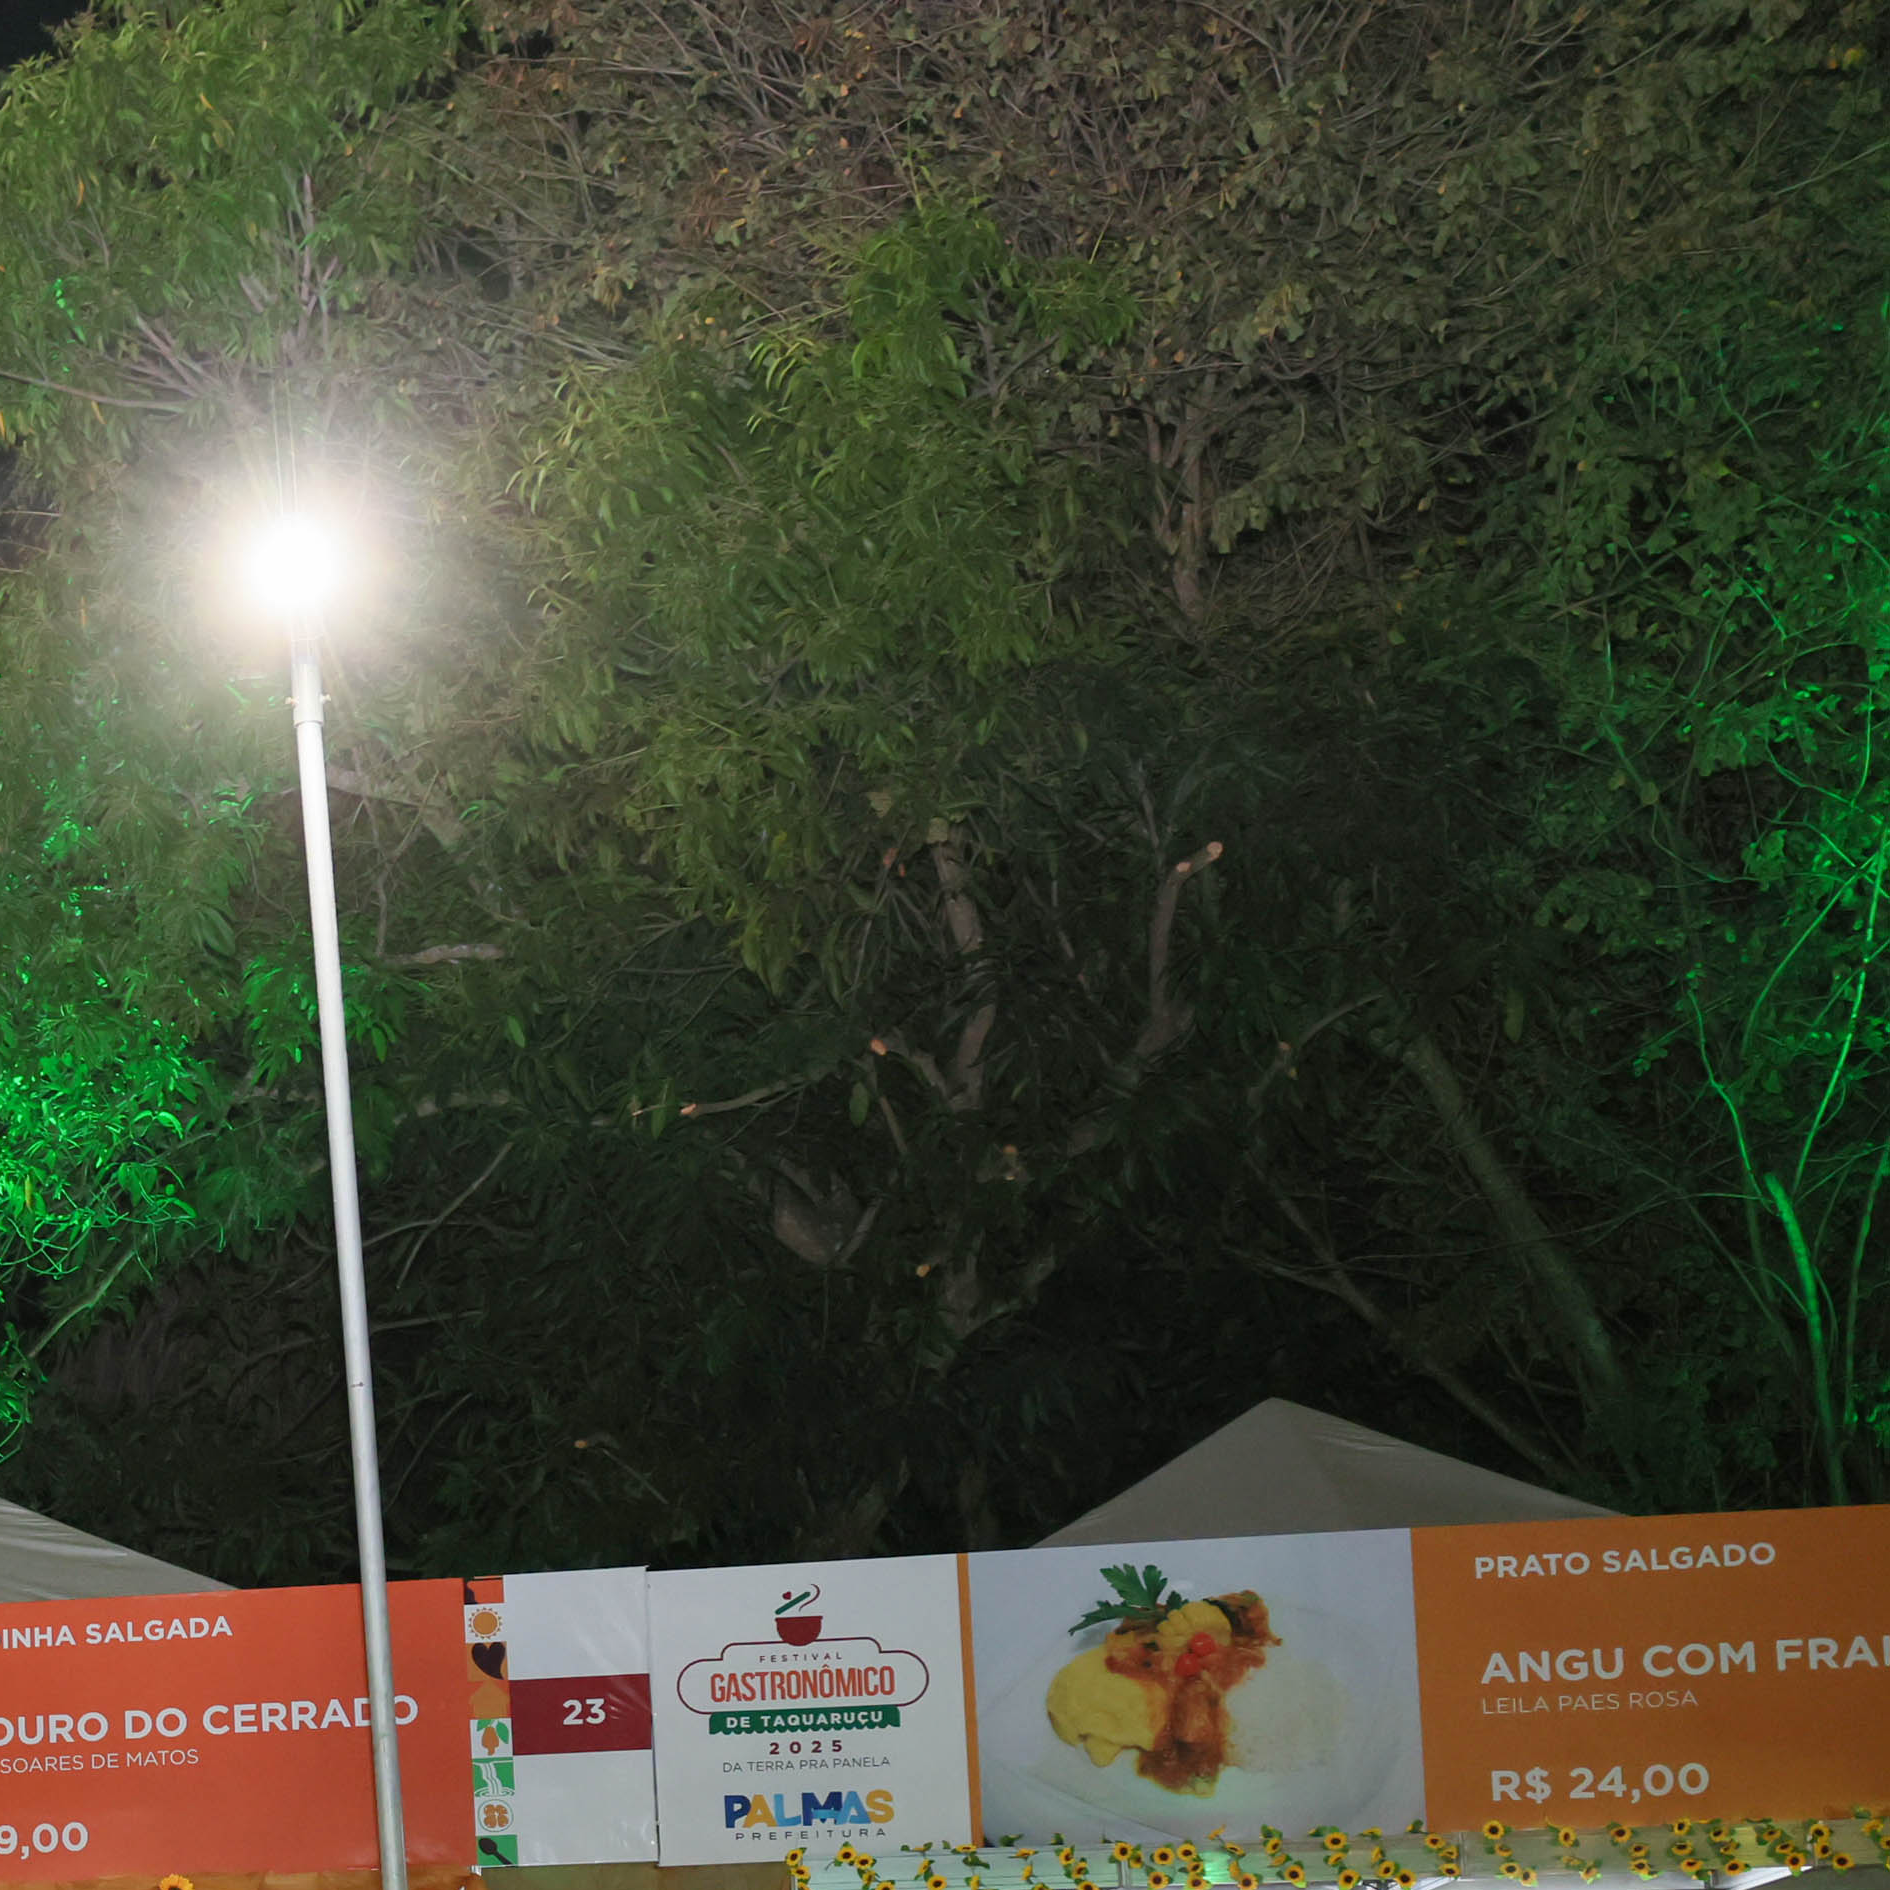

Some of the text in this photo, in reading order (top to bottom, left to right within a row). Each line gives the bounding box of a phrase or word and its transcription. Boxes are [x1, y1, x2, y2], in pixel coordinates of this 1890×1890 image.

[1474, 1542, 1776, 1579] PRATO SALGADO
[85, 1615, 233, 1645] SALGADA
[759, 1651, 843, 1664] FESTIVAL
[1481, 1635, 1890, 1684] ANGU COM FRA
[709, 1664, 896, 1703] GASTRONÔMICO
[562, 1698, 606, 1726] 23
[1482, 1689, 1699, 1715] LEILA PAES ROSA
[124, 1707, 188, 1740] DO
[725, 1710, 884, 1729] DE TAQUARUÇU
[768, 1739, 843, 1755] 2025
[0, 1754, 84, 1775] SOARES
[91, 1753, 119, 1770] DE
[126, 1748, 200, 1767] MATOS
[722, 1755, 891, 1773] DA TERRA PRA PANELA
[1491, 1762, 1709, 1804] R$ 24,00
[724, 1789, 895, 1829] PALMAS
[735, 1828, 887, 1841] PREFEITURA
